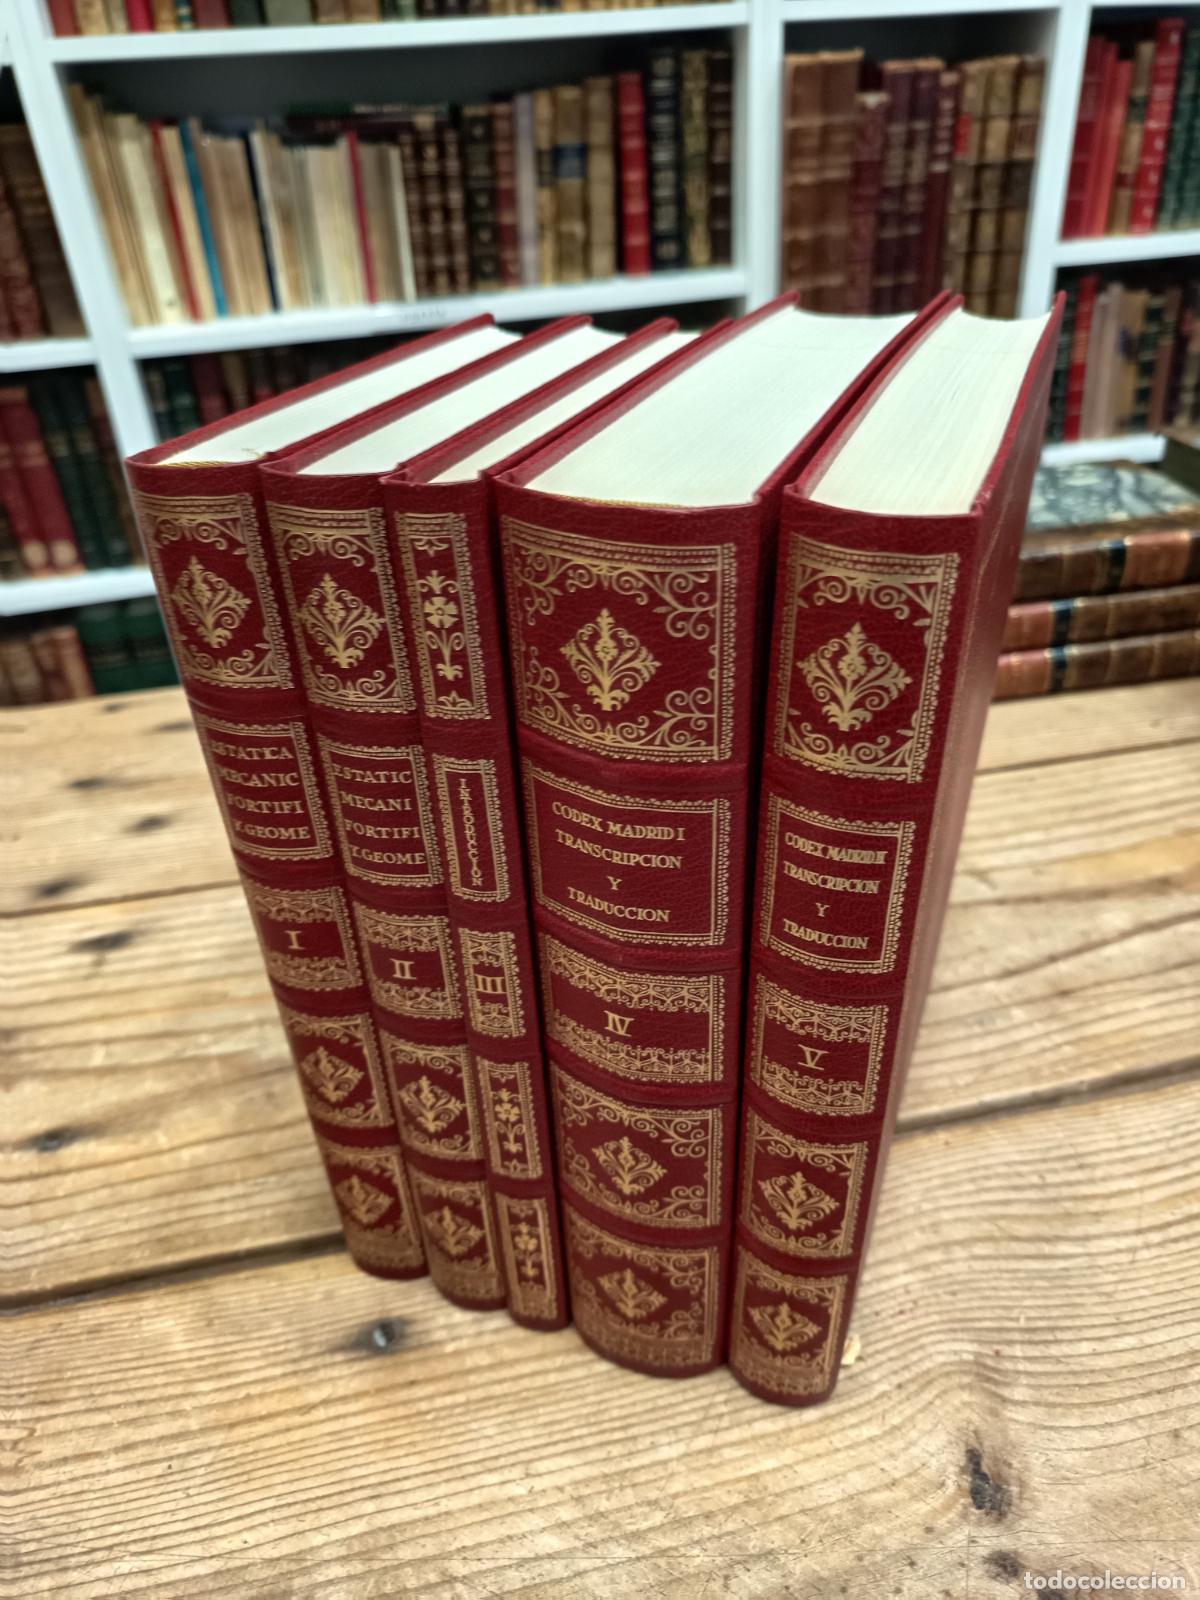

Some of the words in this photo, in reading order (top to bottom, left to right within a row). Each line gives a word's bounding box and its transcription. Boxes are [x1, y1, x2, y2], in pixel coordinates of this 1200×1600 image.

[331, 763, 413, 784] ESTATIC
[226, 793, 305, 814] FORTIFI
[339, 790, 413, 811] MECANI
[343, 818, 420, 839] FORTIFI
[551, 801, 604, 832] CODEX
[605, 821, 676, 840] MADRID
[676, 827, 686, 841] I
[554, 828, 683, 869] TRANSCRIPCION
[784, 831, 830, 859] CODEX
[606, 875, 623, 891] Y
[783, 860, 881, 894] TRANSCRIPCION
[567, 886, 671, 922] TRADUCCION
[815, 902, 831, 918] Y
[285, 930, 305, 950] I
[783, 918, 870, 950] TRADUCCION
[390, 958, 417, 980] II
[474, 973, 507, 994] III
[604, 1010, 635, 1038] IV
[797, 1044, 830, 1071] V
